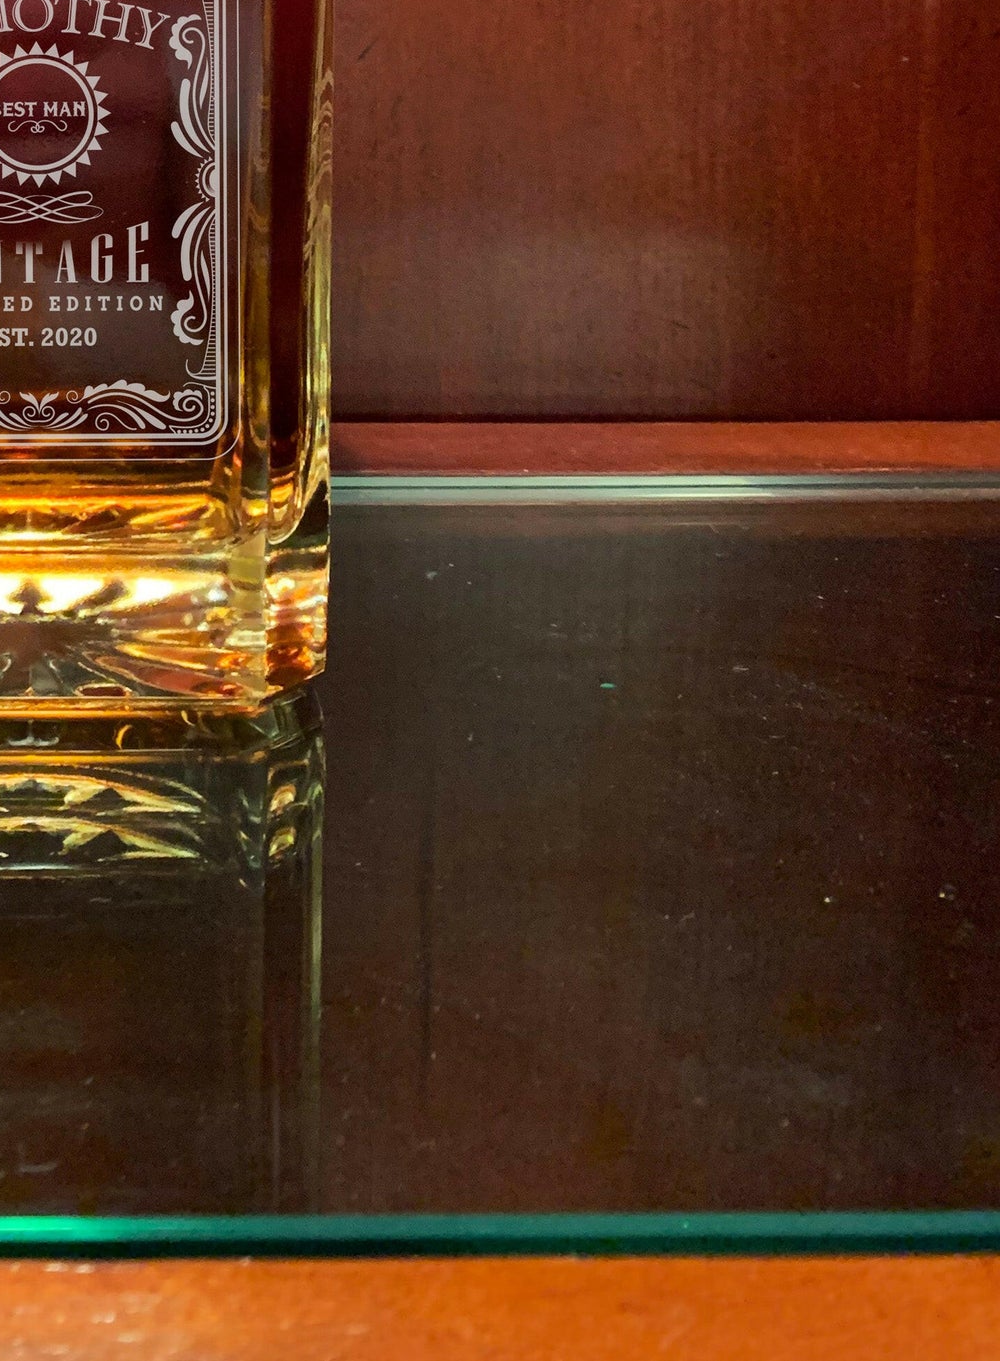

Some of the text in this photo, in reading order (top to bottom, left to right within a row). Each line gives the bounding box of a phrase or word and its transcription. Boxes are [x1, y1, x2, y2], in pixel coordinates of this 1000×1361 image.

[43, 101, 87, 117] MAN
[49, 295, 165, 312] EDITION
[41, 327, 98, 347] 2020
